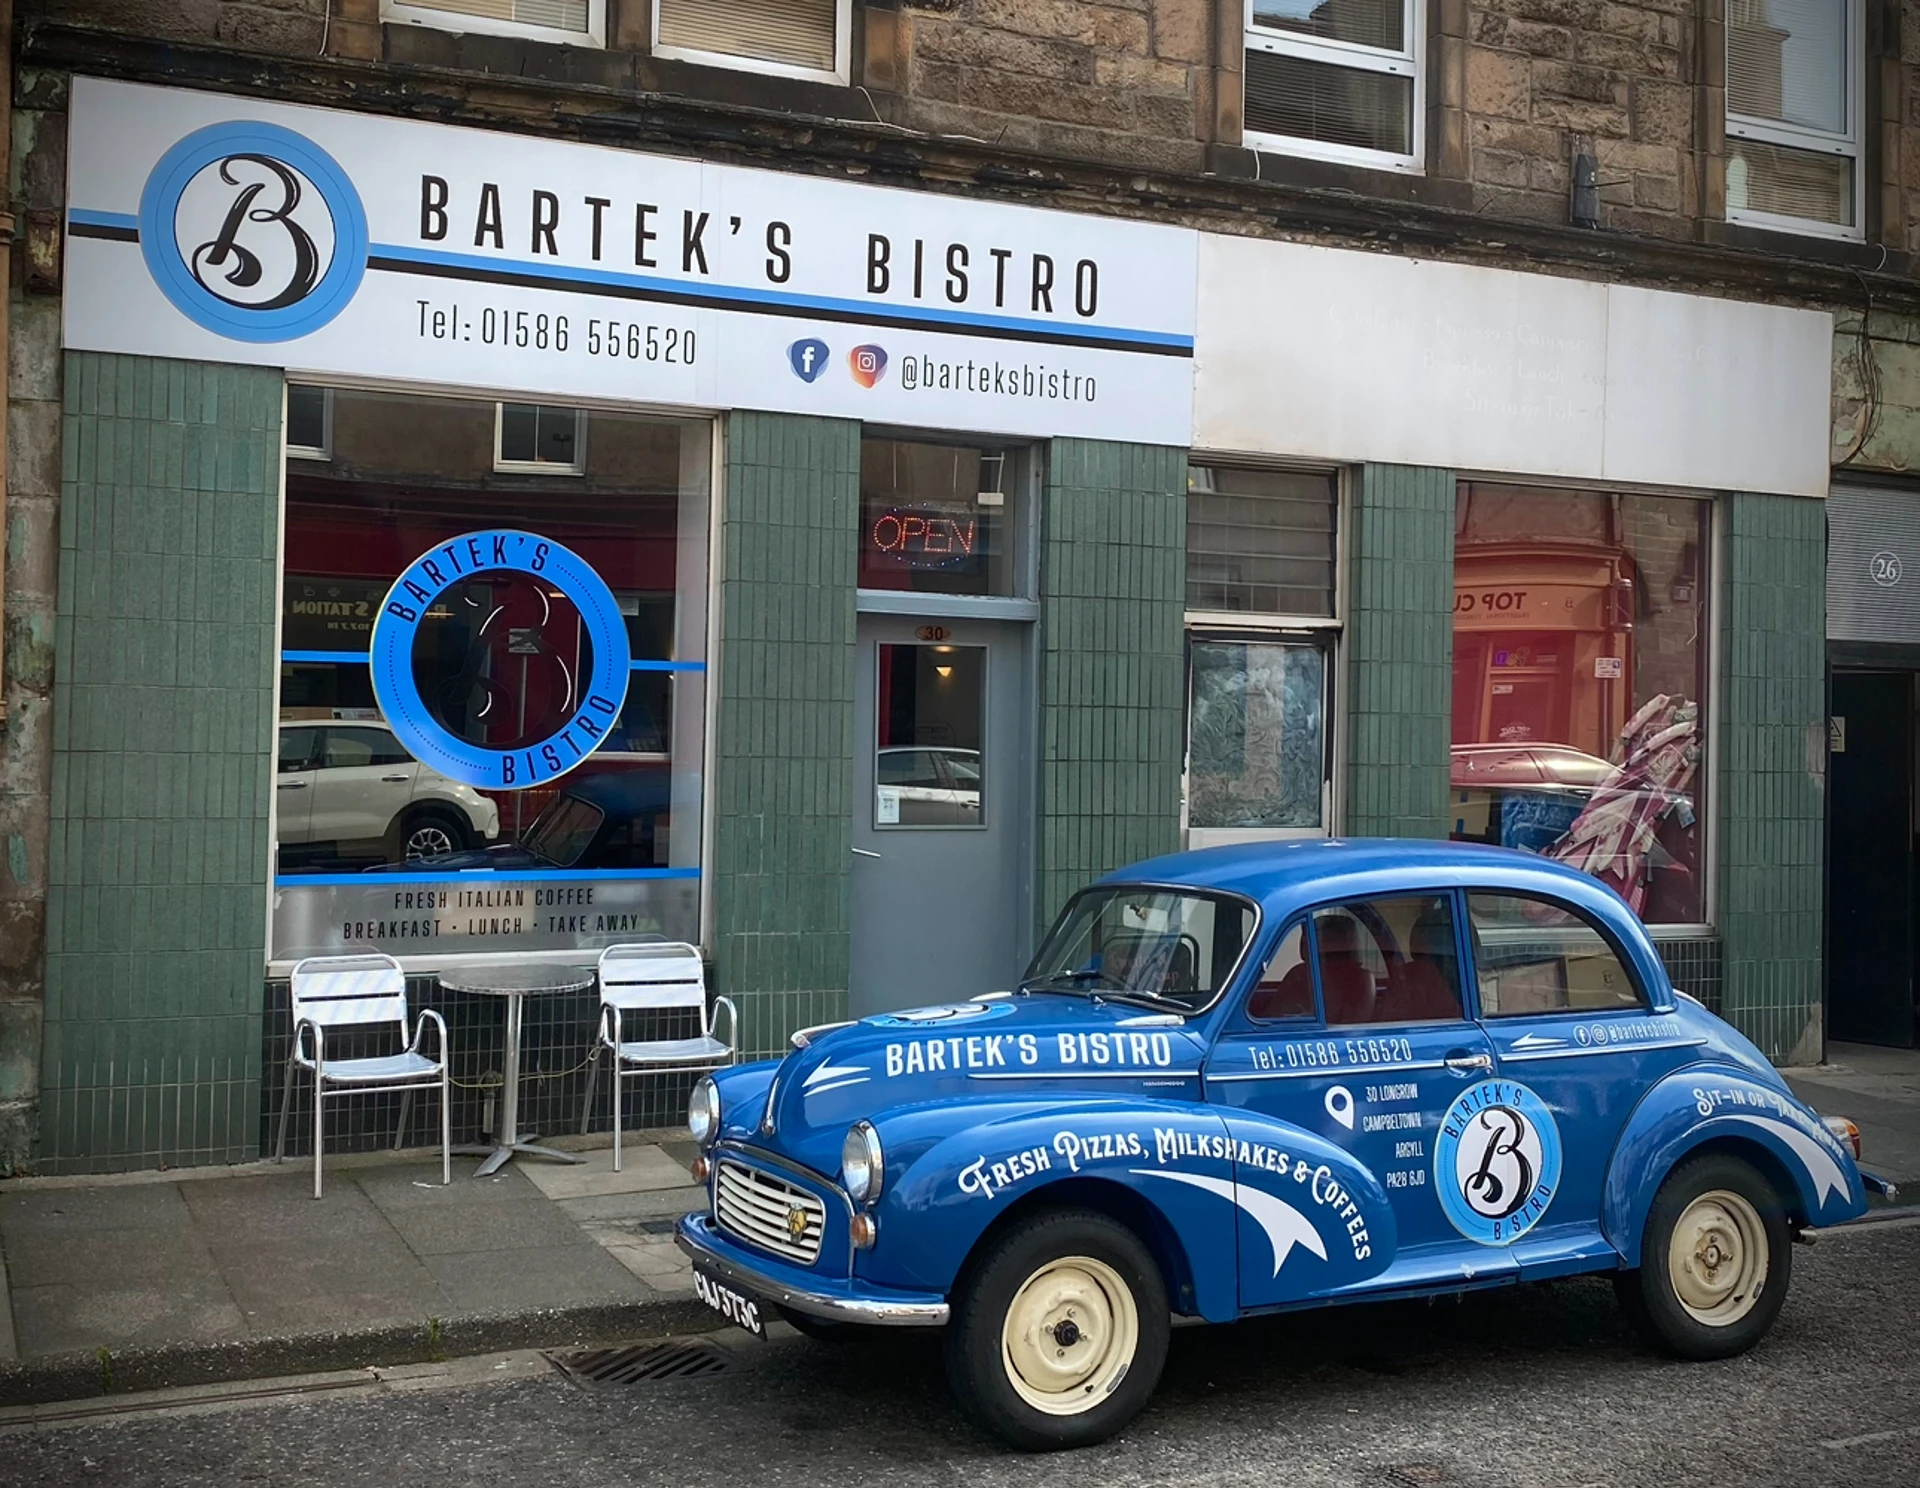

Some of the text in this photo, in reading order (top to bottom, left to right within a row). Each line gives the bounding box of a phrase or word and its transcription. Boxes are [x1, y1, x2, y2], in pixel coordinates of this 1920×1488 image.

[421, 175, 1098, 317] BARTEK'S BISTRO
[588, 319, 696, 365] 556520
[902, 354, 1097, 402] @barteksbistro
[873, 515, 974, 554] OPEN
[386, 535, 549, 624] BARTEK'S
[1876, 558, 1897, 580] 26
[925, 626, 943, 640] 30
[502, 695, 616, 784] BISTRO
[395, 888, 594, 909] FRESH ITALIAN COFFEE
[344, 914, 639, 939] BREAKFAST LUNCH TAKE AWAY
[886, 1032, 1171, 1077] BARTEK'S BISTRO
[1346, 1038, 1412, 1064] 556520
[1365, 1083, 1418, 1103] 30 LONGROW
[1363, 1112, 1422, 1132] CAMPBELTOWN
[1444, 1084, 1523, 1139] BARTEK'S
[1395, 1141, 1424, 1158] ARGYLL
[1464, 1105, 1533, 1219] B
[1292, 1161, 1309, 1183] &
[1386, 1170, 1425, 1188] PA28 6JD
[1493, 1184, 1552, 1240] BSTRO
